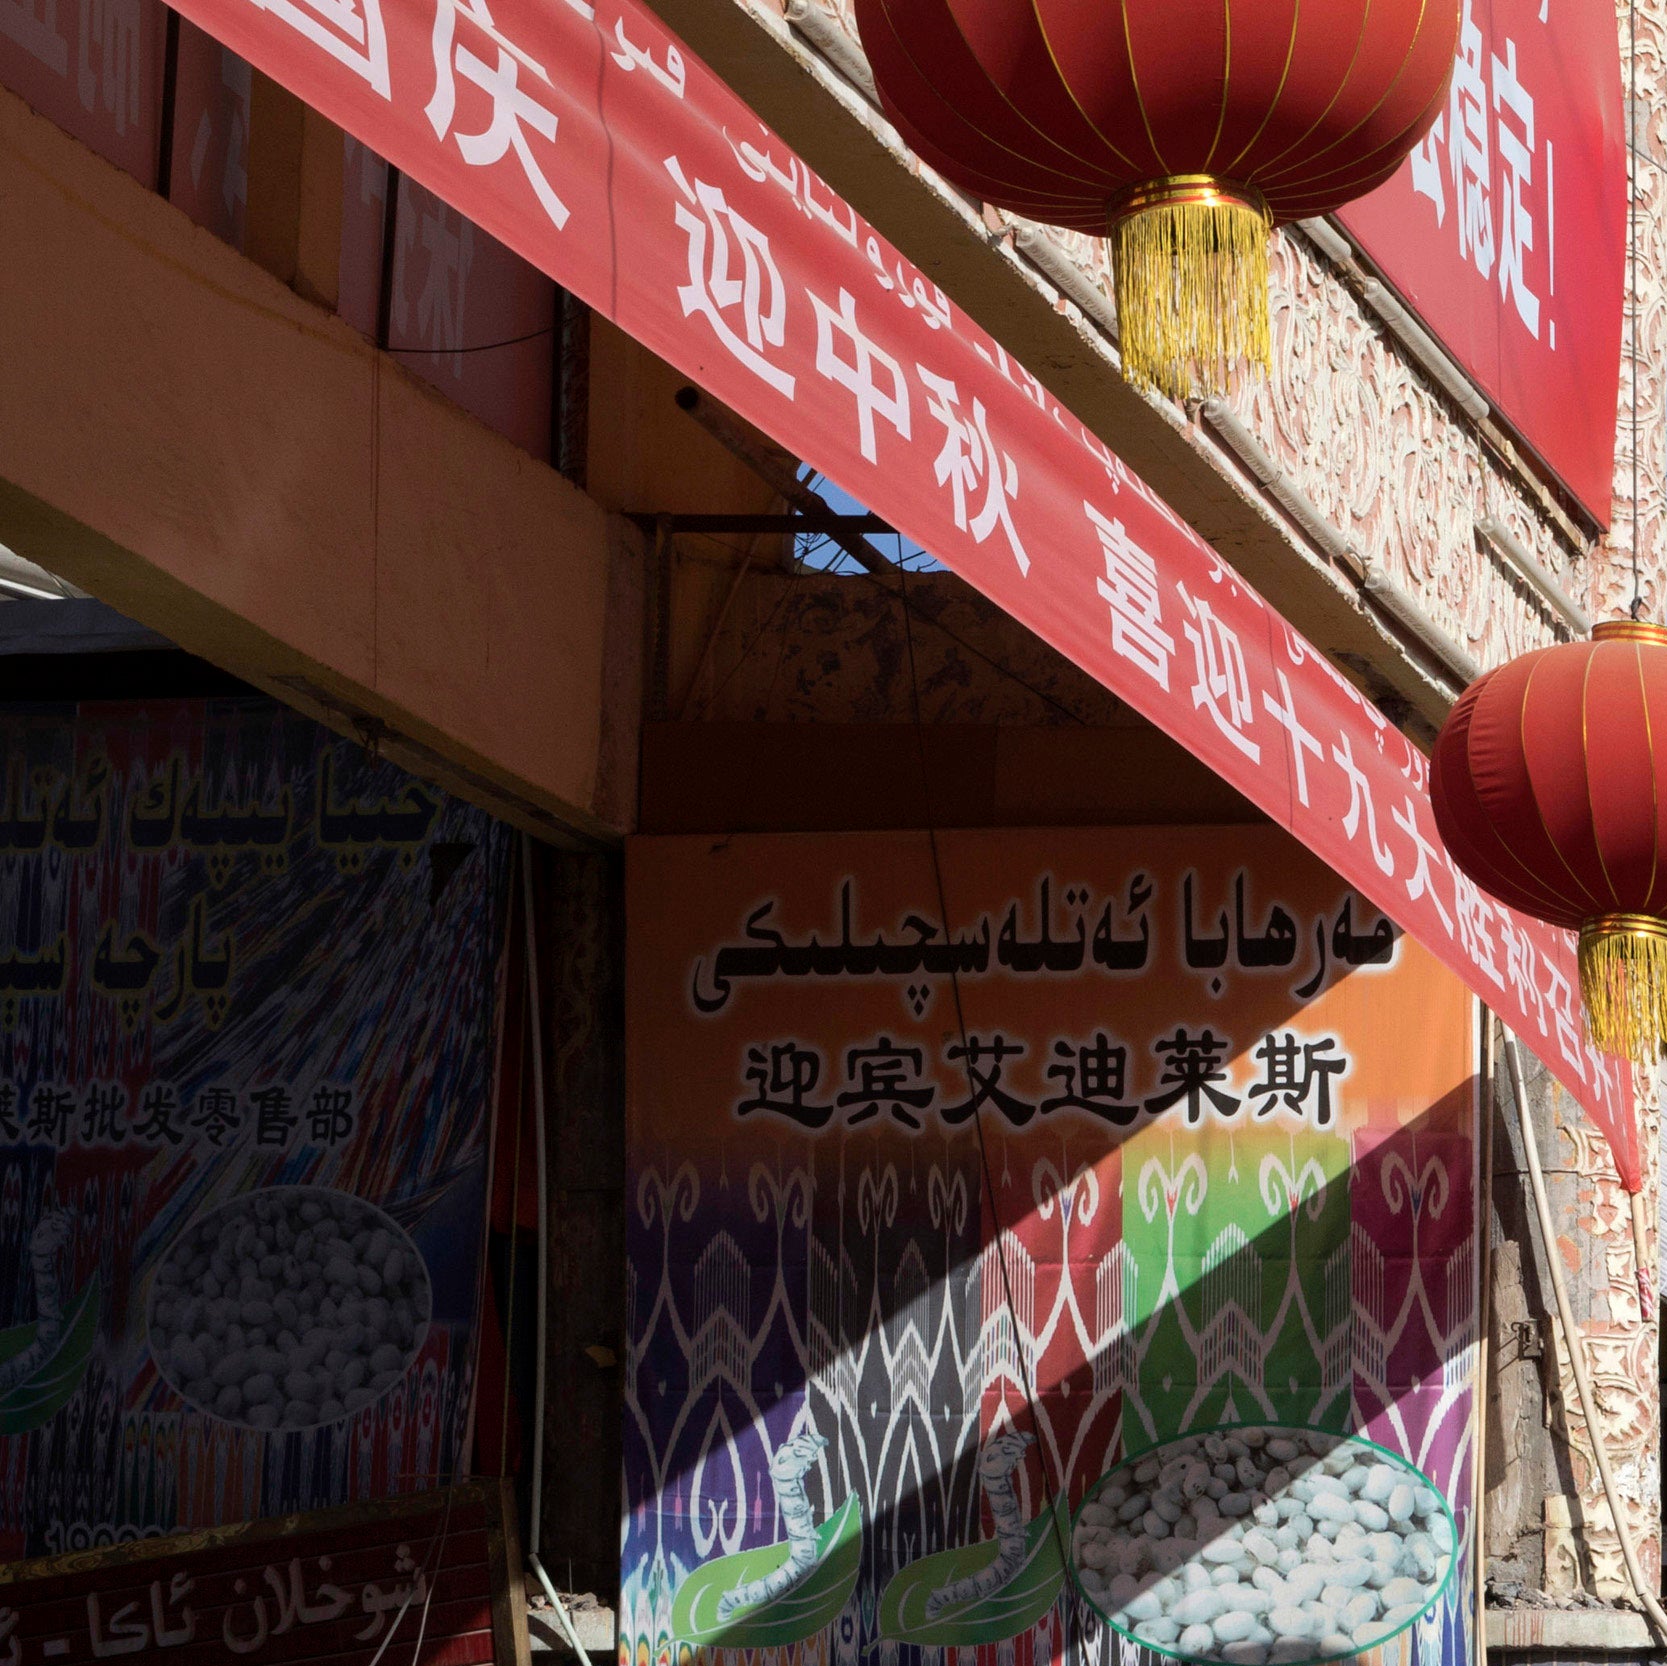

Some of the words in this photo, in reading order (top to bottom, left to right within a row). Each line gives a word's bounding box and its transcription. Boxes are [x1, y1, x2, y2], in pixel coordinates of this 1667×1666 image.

[664, 155, 1031, 579] 迎中秋
[737, 1028, 1347, 1130] 迎宾艾迪莱斯
